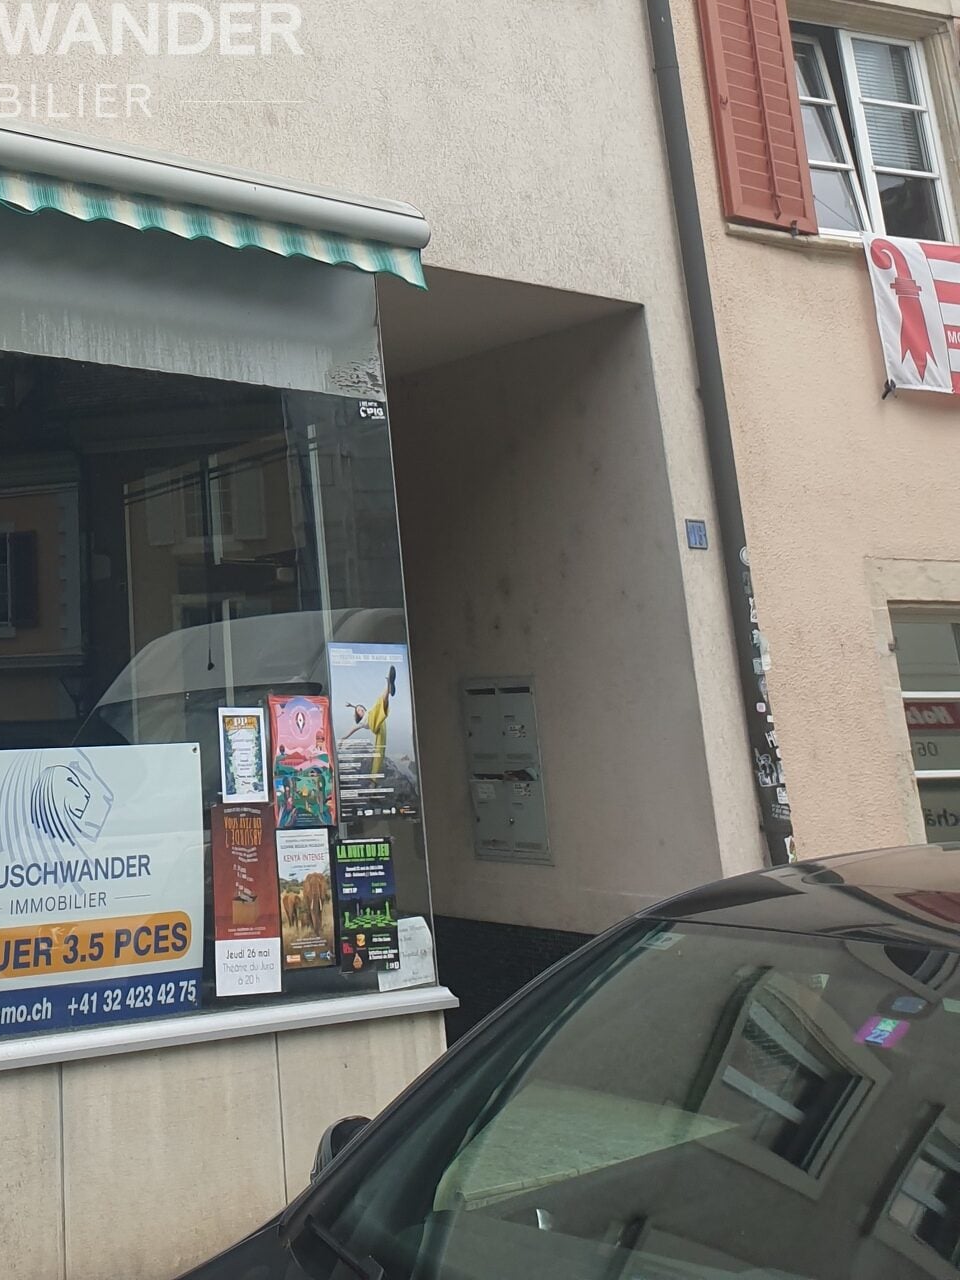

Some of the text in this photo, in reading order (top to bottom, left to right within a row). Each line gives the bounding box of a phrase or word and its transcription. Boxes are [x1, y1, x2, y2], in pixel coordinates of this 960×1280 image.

[283, 852, 325, 862] KENYA INTENSE
[336, 843, 390, 858] LA NUIT DU JEU
[9, 891, 108, 915] IMMOBILIER
[62, 932, 104, 964] 3.5
[114, 922, 188, 959] PCES
[226, 948, 271, 959] Jeudi 26 mai
[249, 961, 259, 971] du
[260, 960, 275, 971] Jura
[245, 975, 254, 985] 20
[67, 991, 98, 1017] +41
[103, 989, 122, 1012] 32
[125, 984, 153, 1009] 423
[157, 982, 175, 1006] 42
[179, 980, 197, 1002] 75
